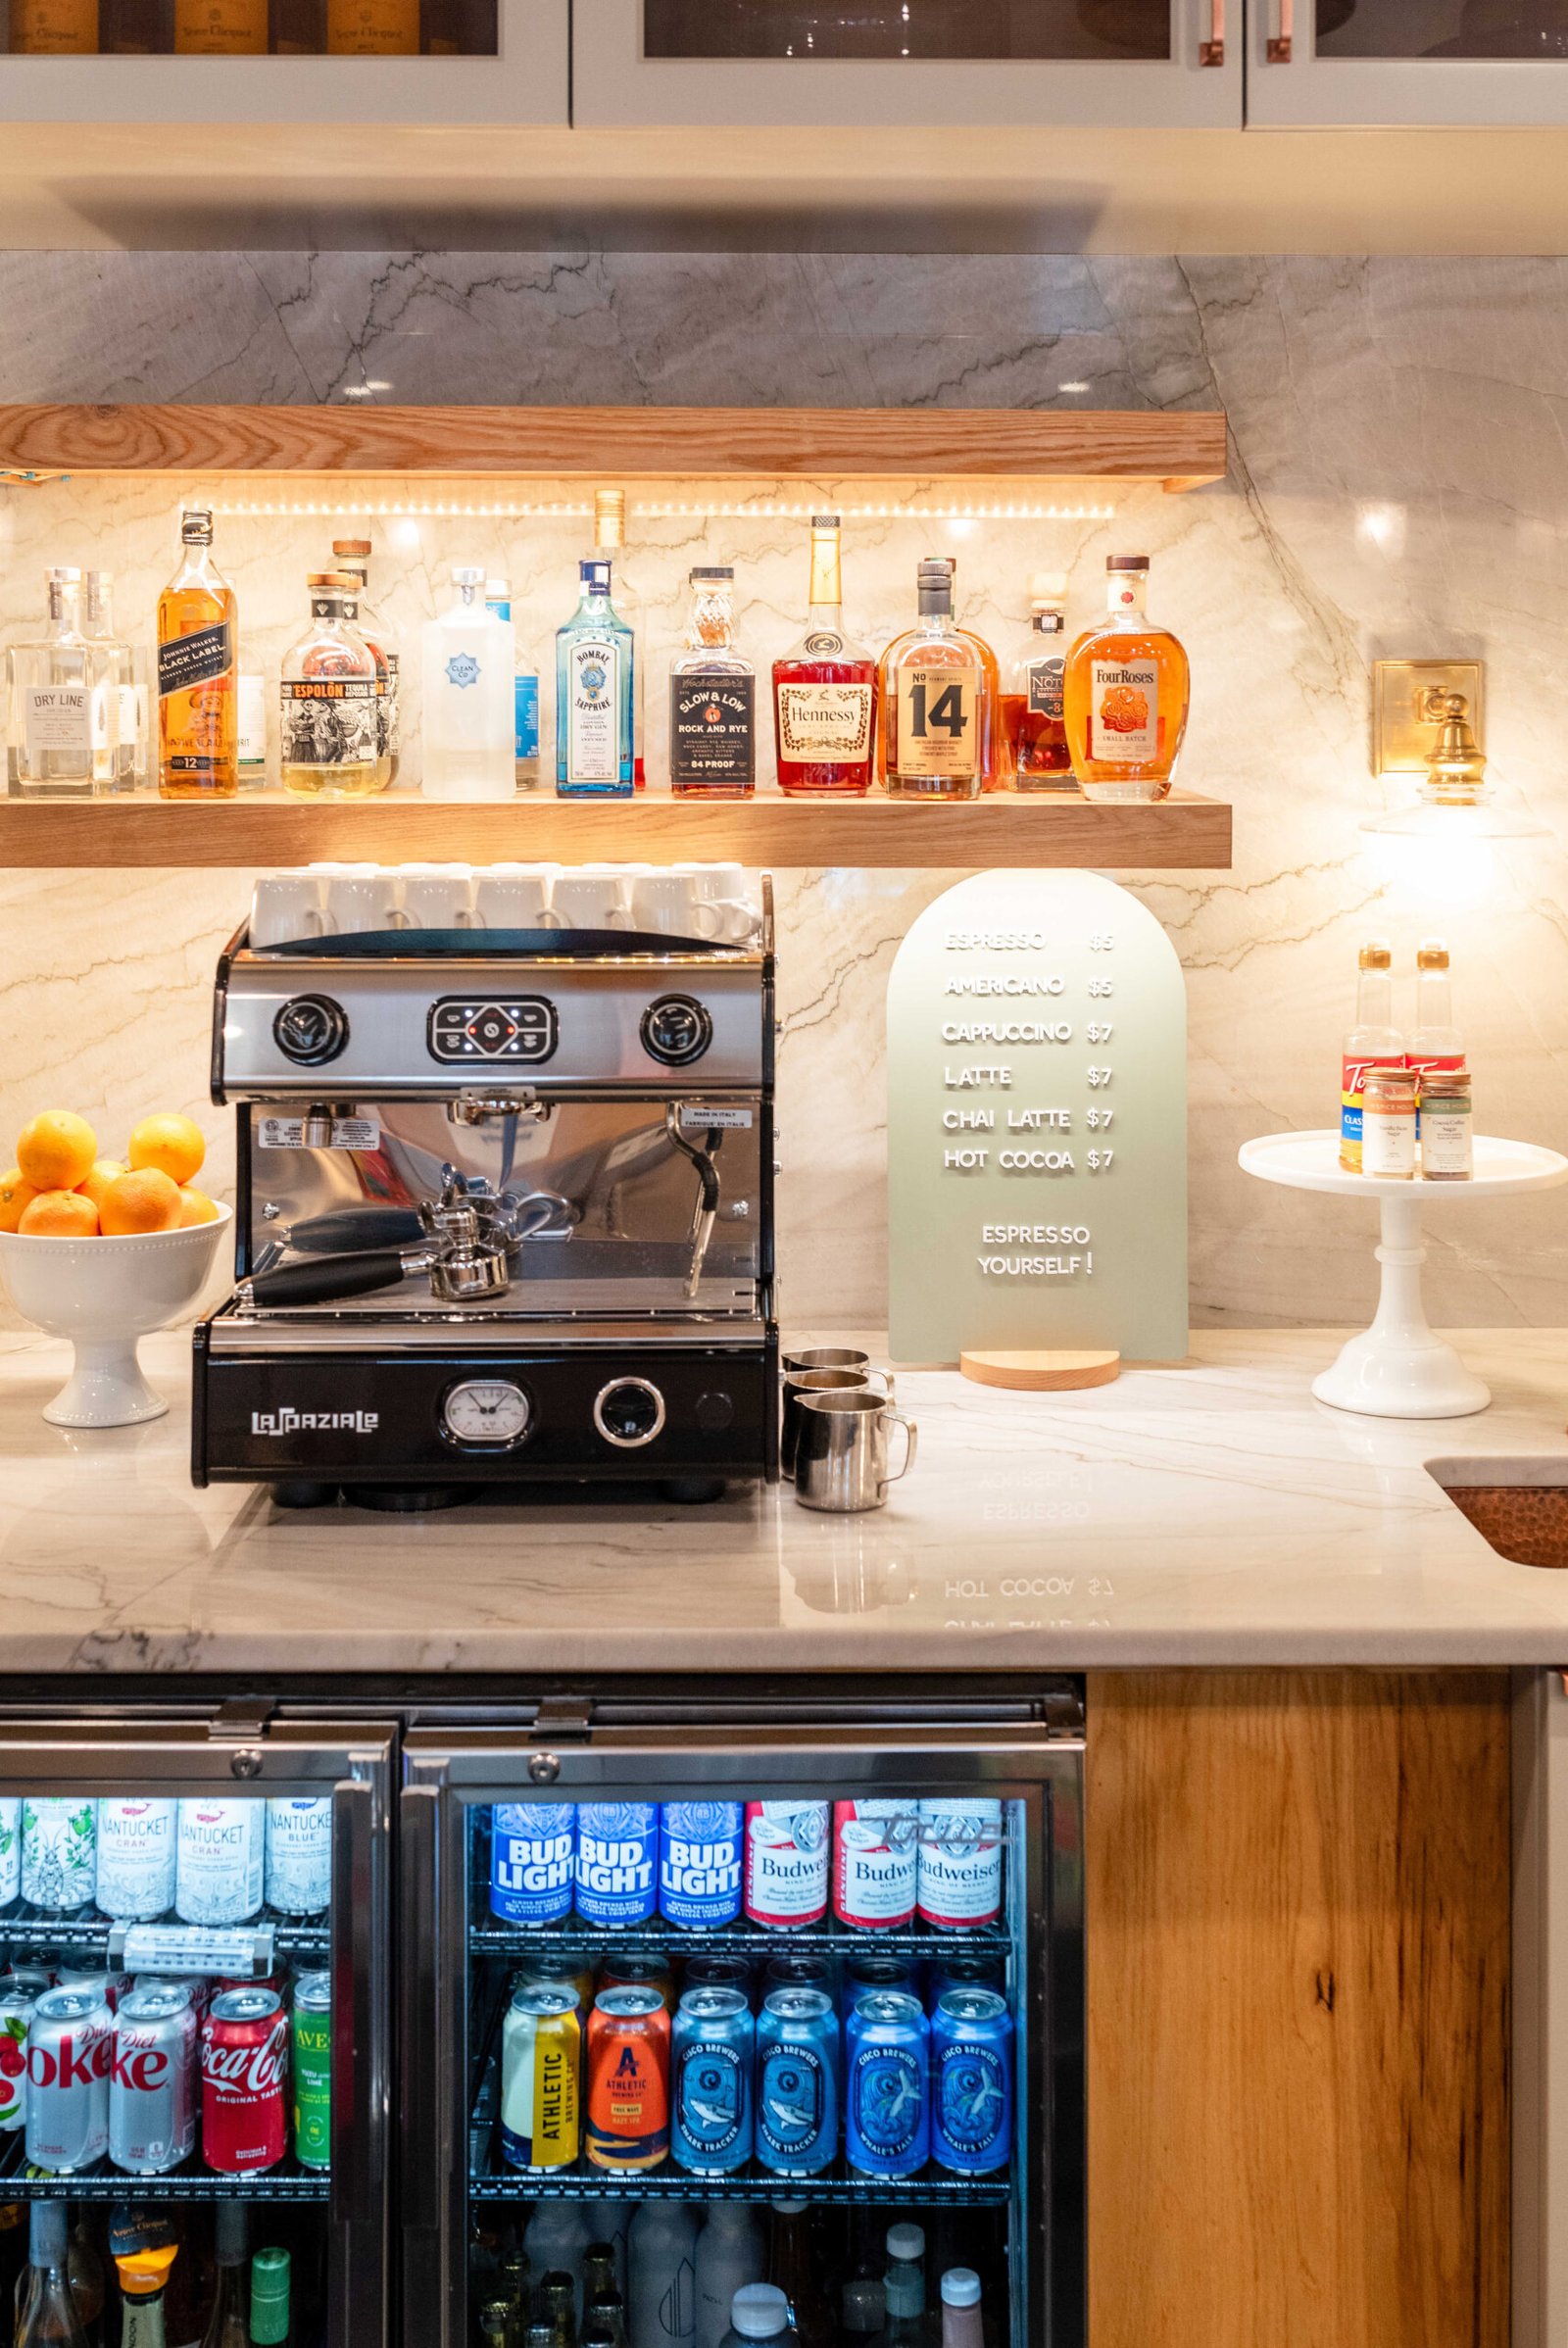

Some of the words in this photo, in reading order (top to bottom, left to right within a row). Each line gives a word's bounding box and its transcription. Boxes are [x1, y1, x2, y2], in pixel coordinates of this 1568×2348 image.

[159, 655, 191, 672] BLACK
[576, 650, 611, 665] BOMBAY
[33, 694, 56, 708] DRY
[60, 694, 84, 708] LINE
[574, 697, 612, 711] SAPPHIRE
[679, 691, 710, 713] SLOW
[710, 691, 720, 702] &
[721, 693, 747, 712] LOW
[907, 684, 968, 738] 14
[792, 707, 857, 724] Hennessy
[678, 724, 704, 733] ROCK
[706, 724, 726, 733] AND
[728, 724, 748, 733] RYE
[183, 757, 197, 768] 12
[945, 930, 1047, 951] ESPRESSO
[1089, 931, 1115, 953] $5
[946, 977, 1065, 996] AMERICANO
[1088, 977, 1114, 998] $5
[941, 1022, 1072, 1042] CAPPUCCINO
[1087, 1021, 1113, 1043] $7
[944, 1066, 1012, 1086] LATTE
[1088, 1065, 1113, 1087] $7
[942, 1109, 995, 1128] CHAI
[1007, 1109, 1071, 1128] LATTE
[1087, 1106, 1114, 1128] $7
[944, 1150, 989, 1168] HOT
[999, 1150, 1074, 1169] COCOA
[1087, 1149, 1114, 1169] $7
[982, 1226, 1091, 1245] ESPRESSO
[977, 1251, 1093, 1275] YOURSELF!
[270, 1810, 332, 1831] NANTUCKE
[116, 1838, 146, 1848] CRAN
[192, 1844, 220, 1855] CRAN
[509, 1834, 572, 1866] BUD
[580, 1834, 643, 1868] BUD
[669, 1838, 735, 1870] BUD
[498, 1853, 574, 1891] LIGHT
[574, 1855, 653, 1893] LIGHT
[662, 1859, 742, 1895] LIGHT
[120, 2028, 157, 2049] Diet
[297, 2029, 330, 2049] AVE
[27, 2033, 112, 2089] oke
[705, 2043, 740, 2064] BREWERS
[783, 2044, 819, 2068] BREWERS
[858, 2048, 881, 2067] CISCO
[882, 2048, 917, 2069] BREWERS
[963, 2045, 999, 2067] BREWERS
[606, 2079, 647, 2091] ATHLETIC
[216, 2095, 258, 2104] ORIGINAL
[542, 2053, 563, 2140] ATHLETIC
[704, 2126, 739, 2153] TRACKER
[784, 2129, 818, 2153] TRACKER
